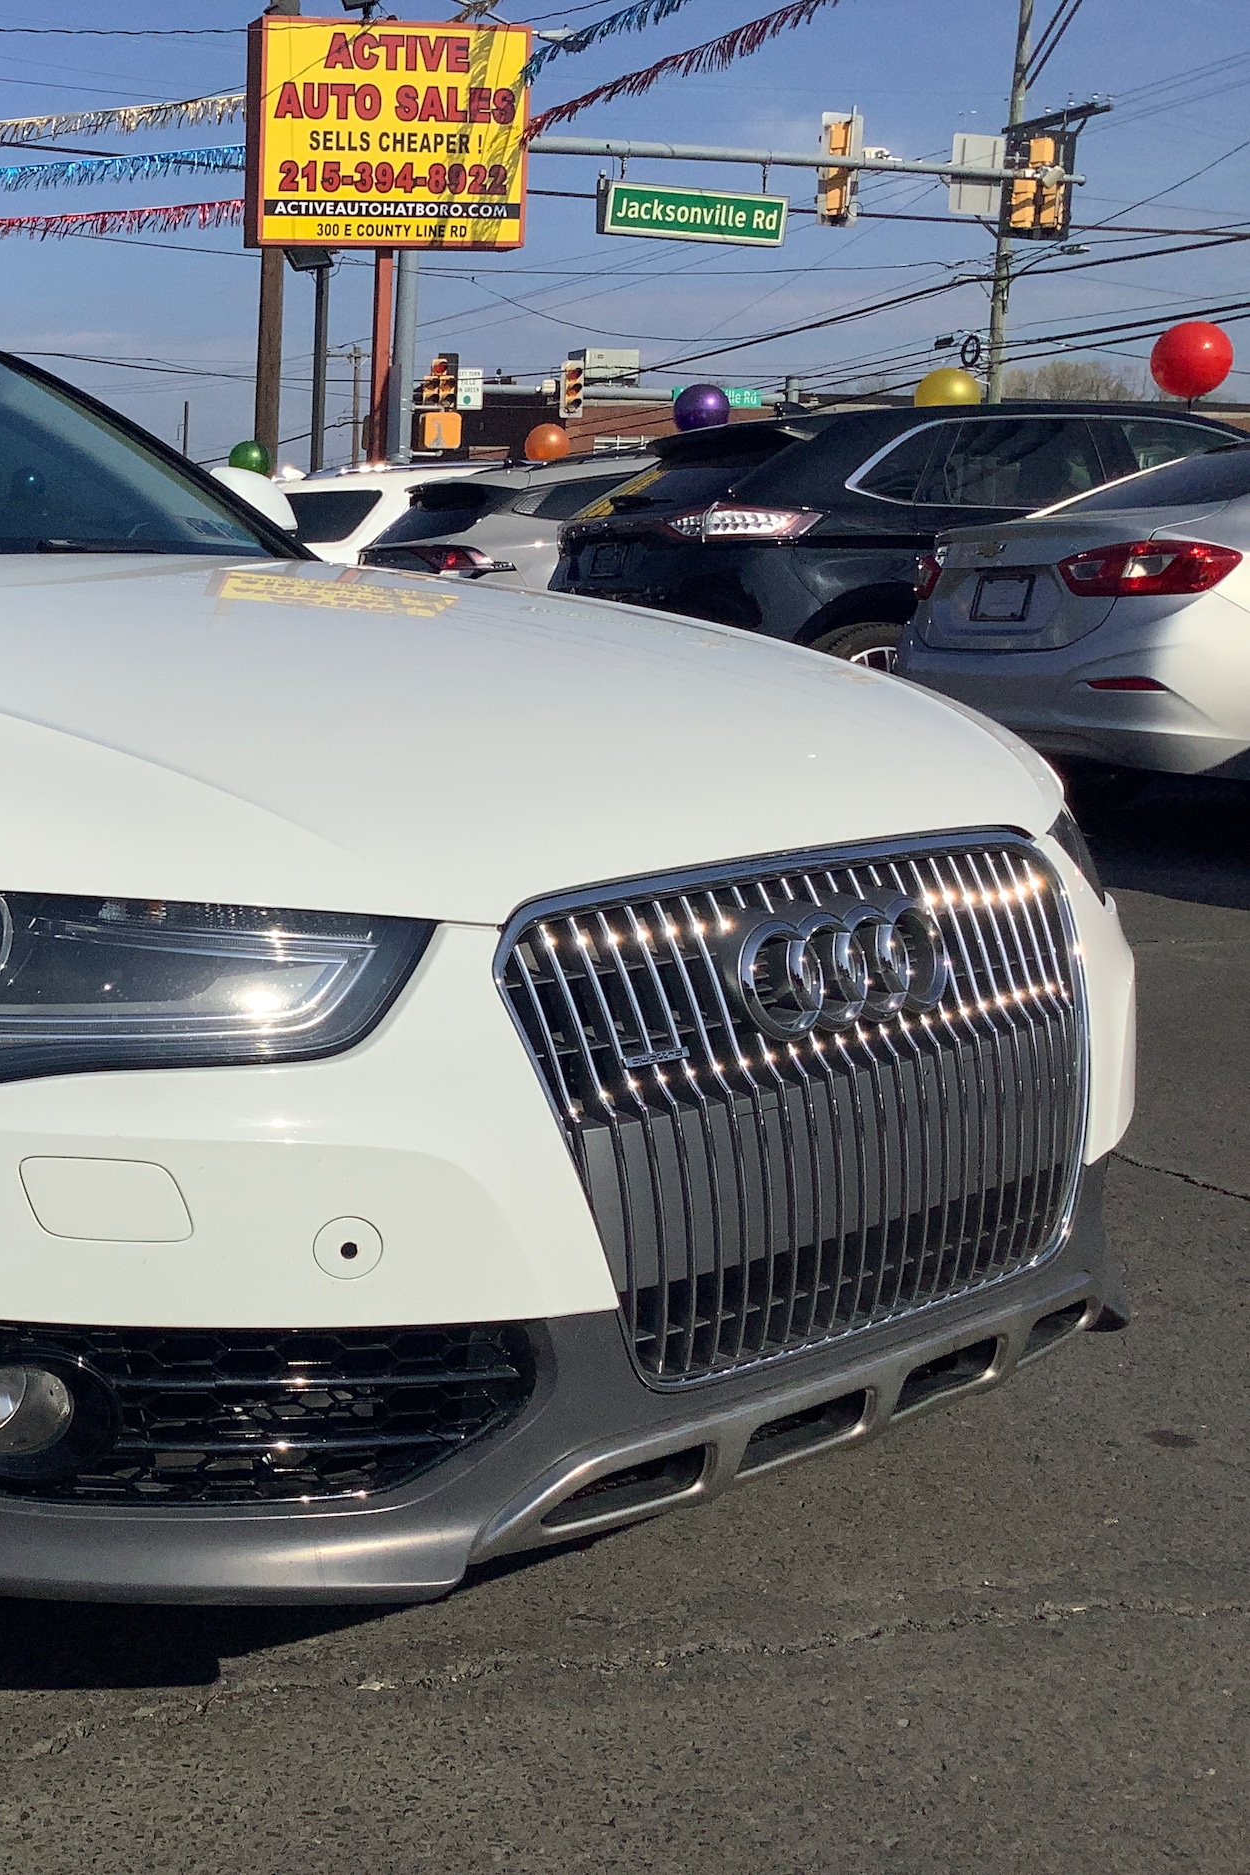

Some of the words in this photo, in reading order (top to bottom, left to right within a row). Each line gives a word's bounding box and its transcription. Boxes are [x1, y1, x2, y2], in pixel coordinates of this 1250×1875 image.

[324, 32, 470, 73] ACTIVE
[274, 82, 382, 121] AUTO
[394, 85, 516, 125] SALES
[309, 130, 370, 152] SELLS
[378, 132, 470, 154] CHEAPER
[278, 160, 507, 195] 215-394-8922
[274, 201, 508, 218] ACTIVEAUTOHATBORO.COM
[616, 197, 746, 228] Jacksonville
[752, 209, 778, 230] Rd
[316, 223, 340, 237] 300
[344, 224, 352, 237] E
[356, 224, 410, 238] COUNTY
[416, 225, 445, 238] LINE
[450, 225, 467, 238] RD
[743, 391, 757, 404] Rd
